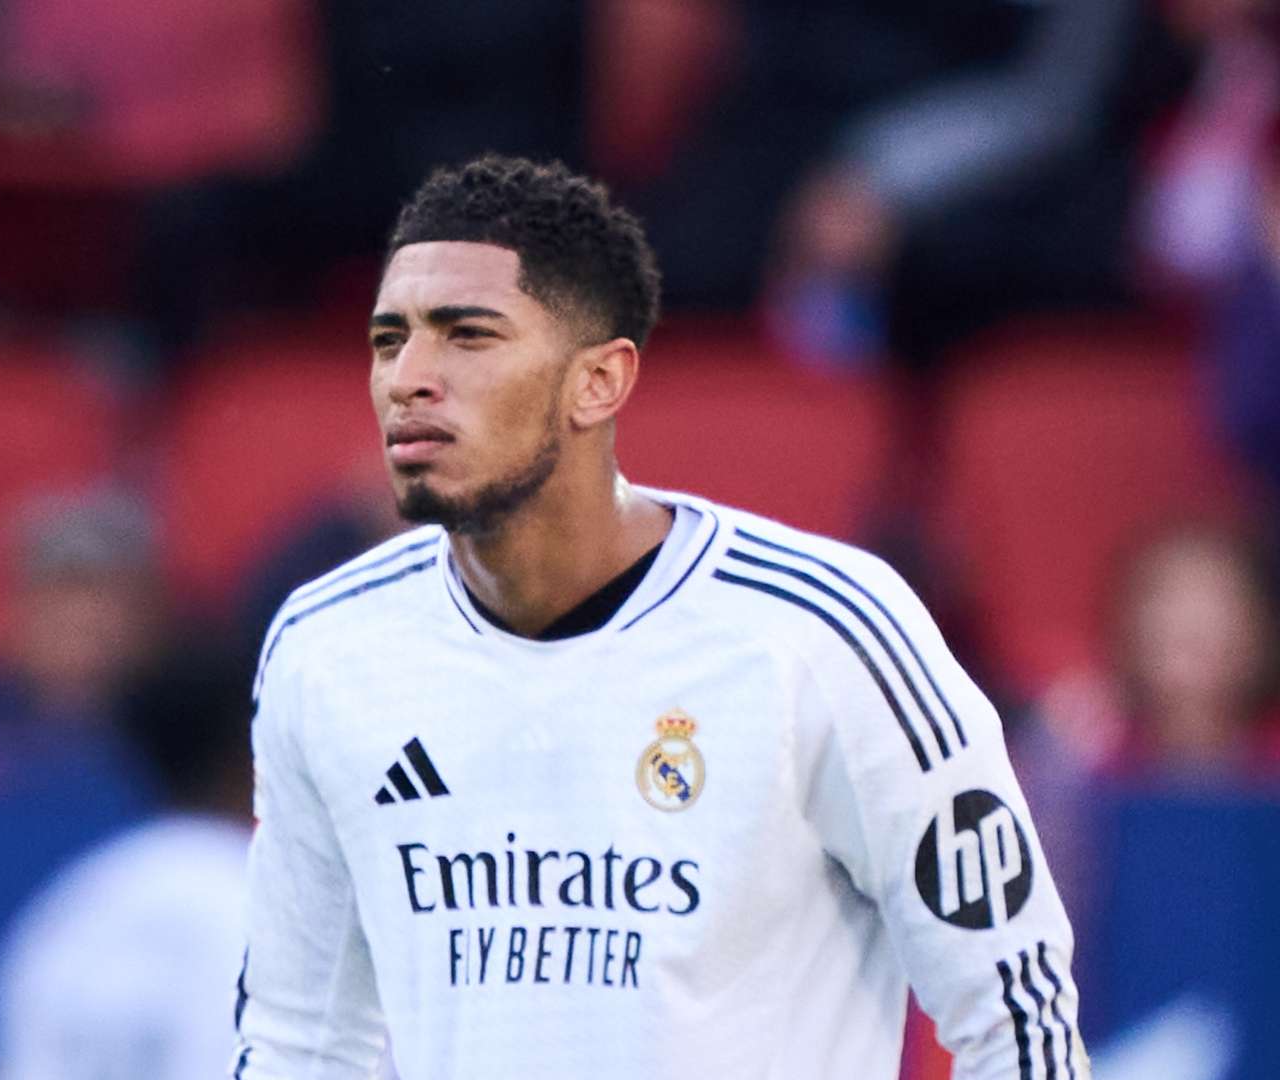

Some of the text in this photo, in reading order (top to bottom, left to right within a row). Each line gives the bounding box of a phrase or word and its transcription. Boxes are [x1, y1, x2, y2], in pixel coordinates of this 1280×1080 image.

[395, 831, 701, 916] Emirates
[935, 788, 1024, 930] hp
[449, 926, 642, 989] FY BETTER
